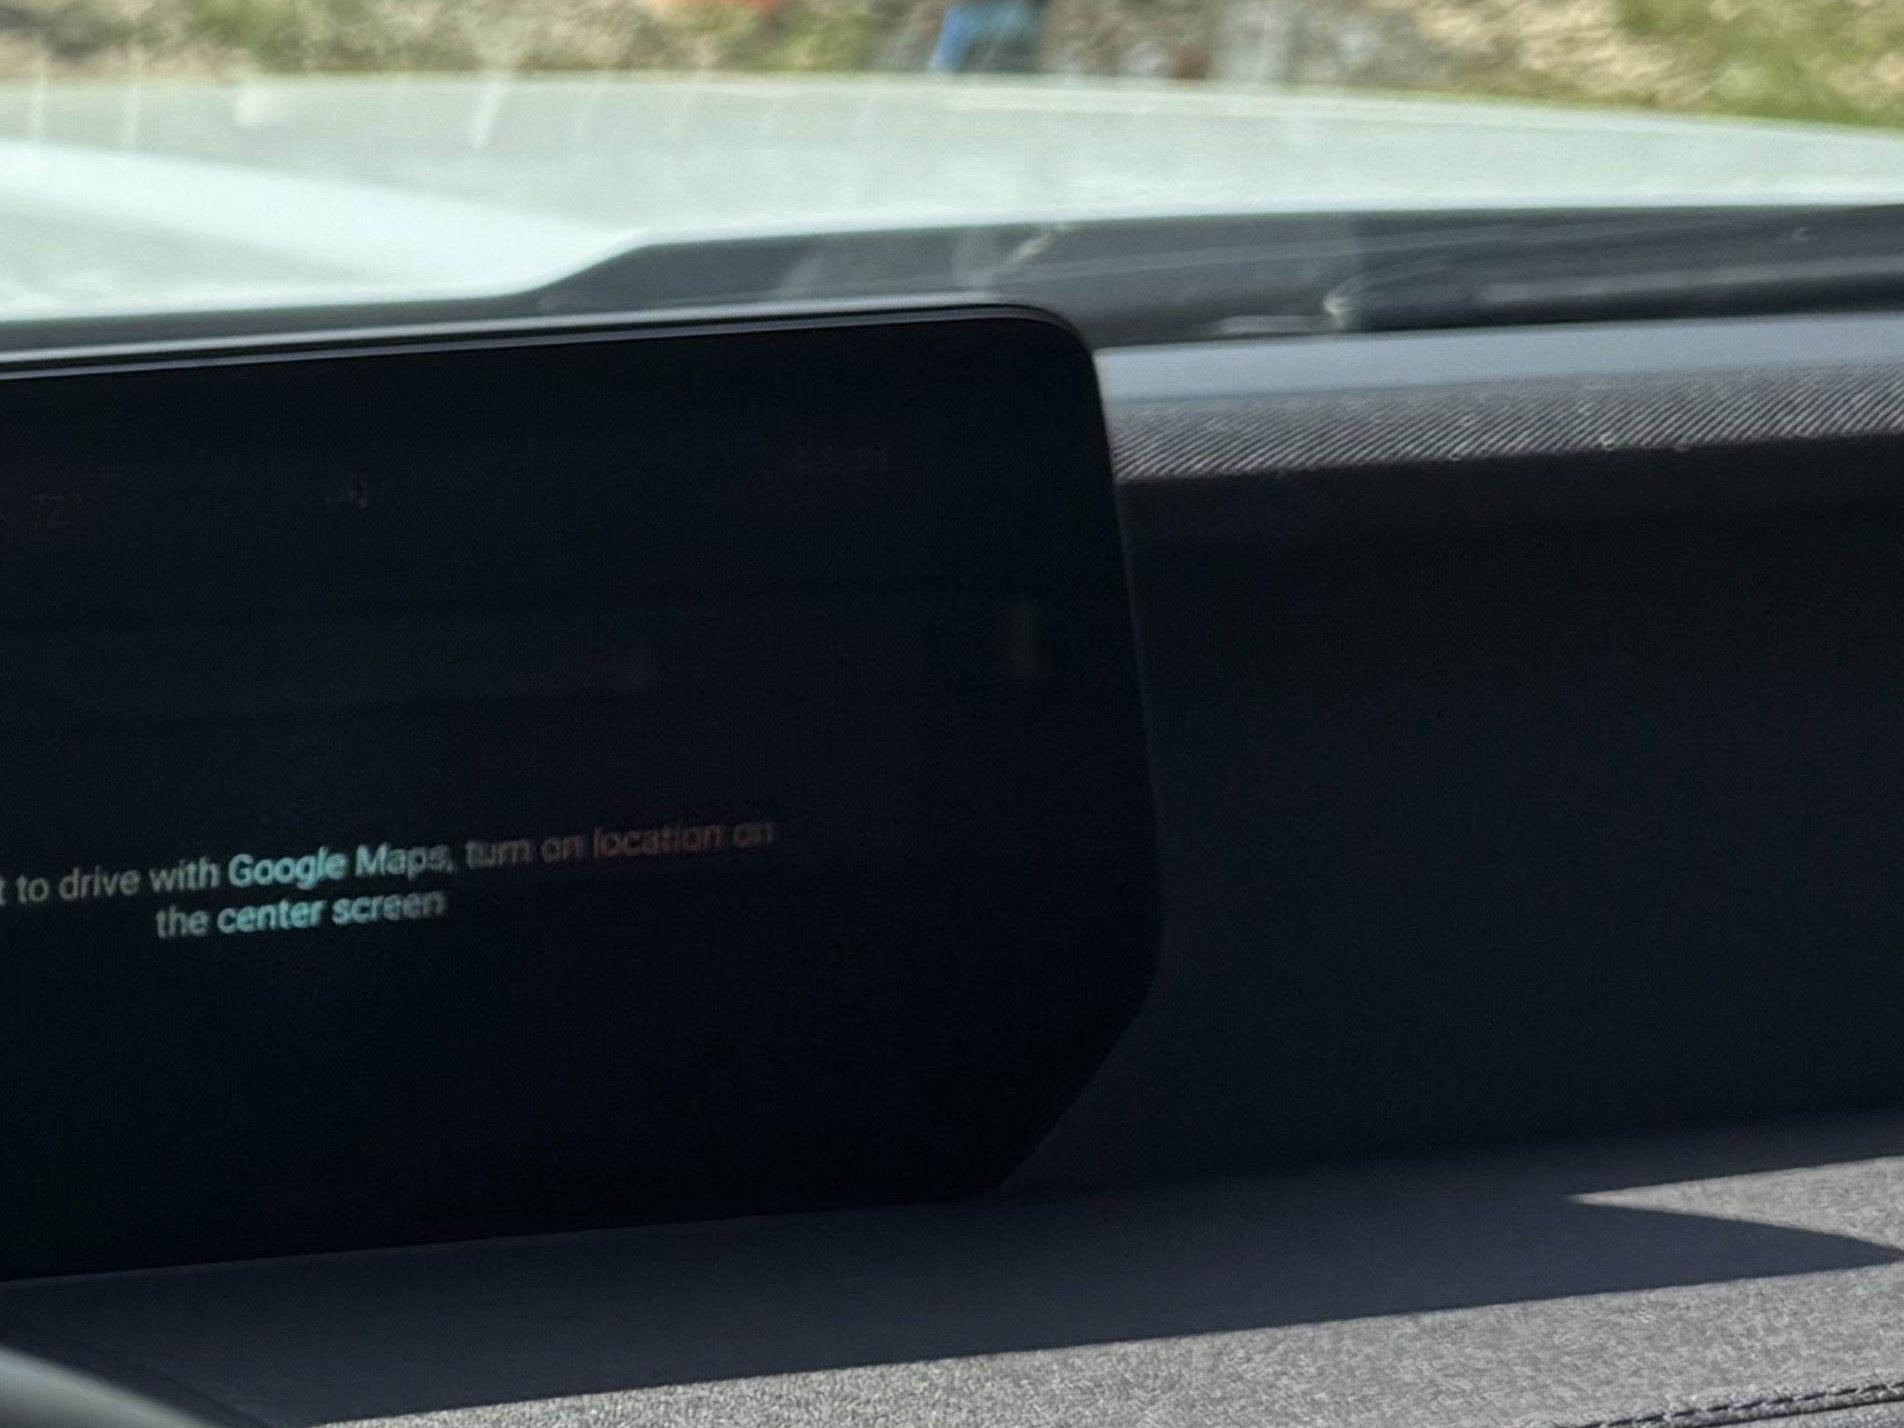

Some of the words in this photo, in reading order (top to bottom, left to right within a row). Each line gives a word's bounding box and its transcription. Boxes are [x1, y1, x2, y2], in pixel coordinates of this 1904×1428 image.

[17, 873, 51, 904] to
[59, 865, 140, 899] drive
[149, 857, 221, 894] with
[228, 845, 346, 895] Google
[356, 837, 457, 880] Maps,
[464, 835, 531, 871] turn
[540, 833, 584, 864] on
[592, 820, 724, 862] location
[732, 818, 775, 849] on
[156, 904, 209, 940] the
[217, 896, 323, 934] center
[332, 888, 446, 928] screen
